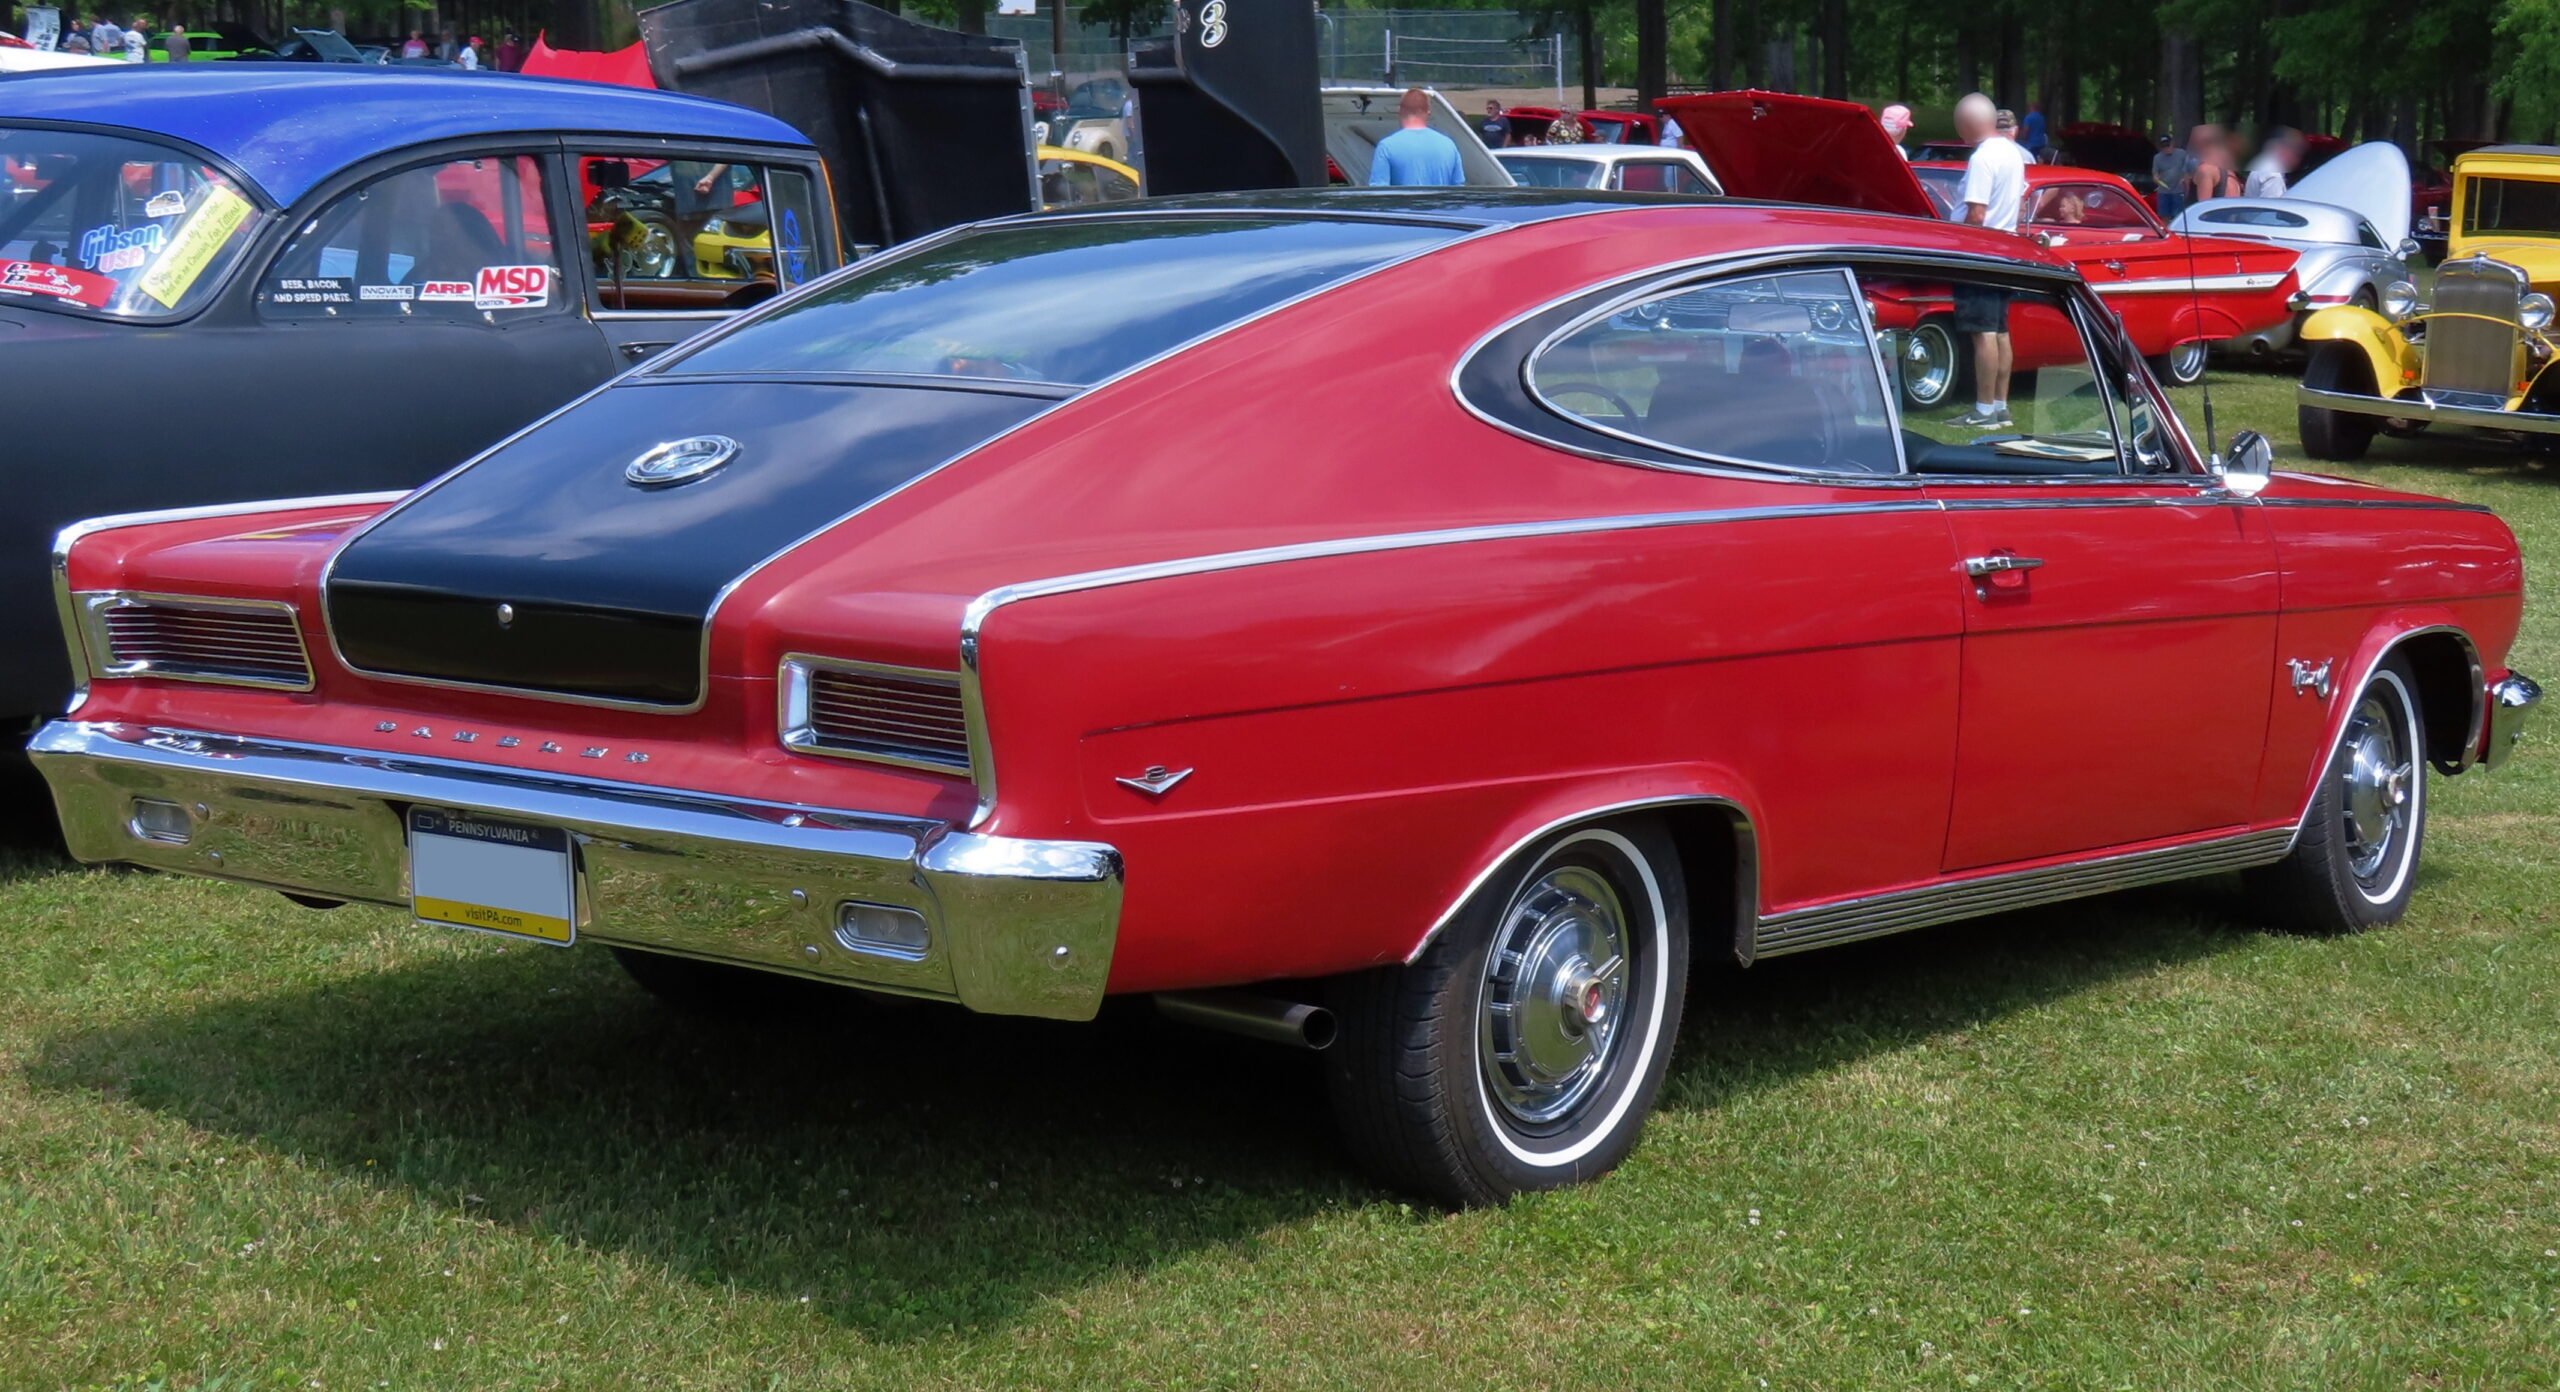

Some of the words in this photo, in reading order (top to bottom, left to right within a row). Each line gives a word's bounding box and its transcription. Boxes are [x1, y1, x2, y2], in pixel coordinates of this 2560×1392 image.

[82, 225, 164, 268] Gibson
[100, 249, 145, 272] USA
[362, 287, 413, 295] INNOVATE
[424, 283, 471, 294] ARP
[480, 267, 546, 295] MSD
[274, 293, 293, 303] AND
[294, 293, 321, 303] SPEED
[323, 293, 353, 303] PARTS.
[449, 820, 529, 843] PENNSYLVANIA
[465, 908, 523, 928] visitPA.com
